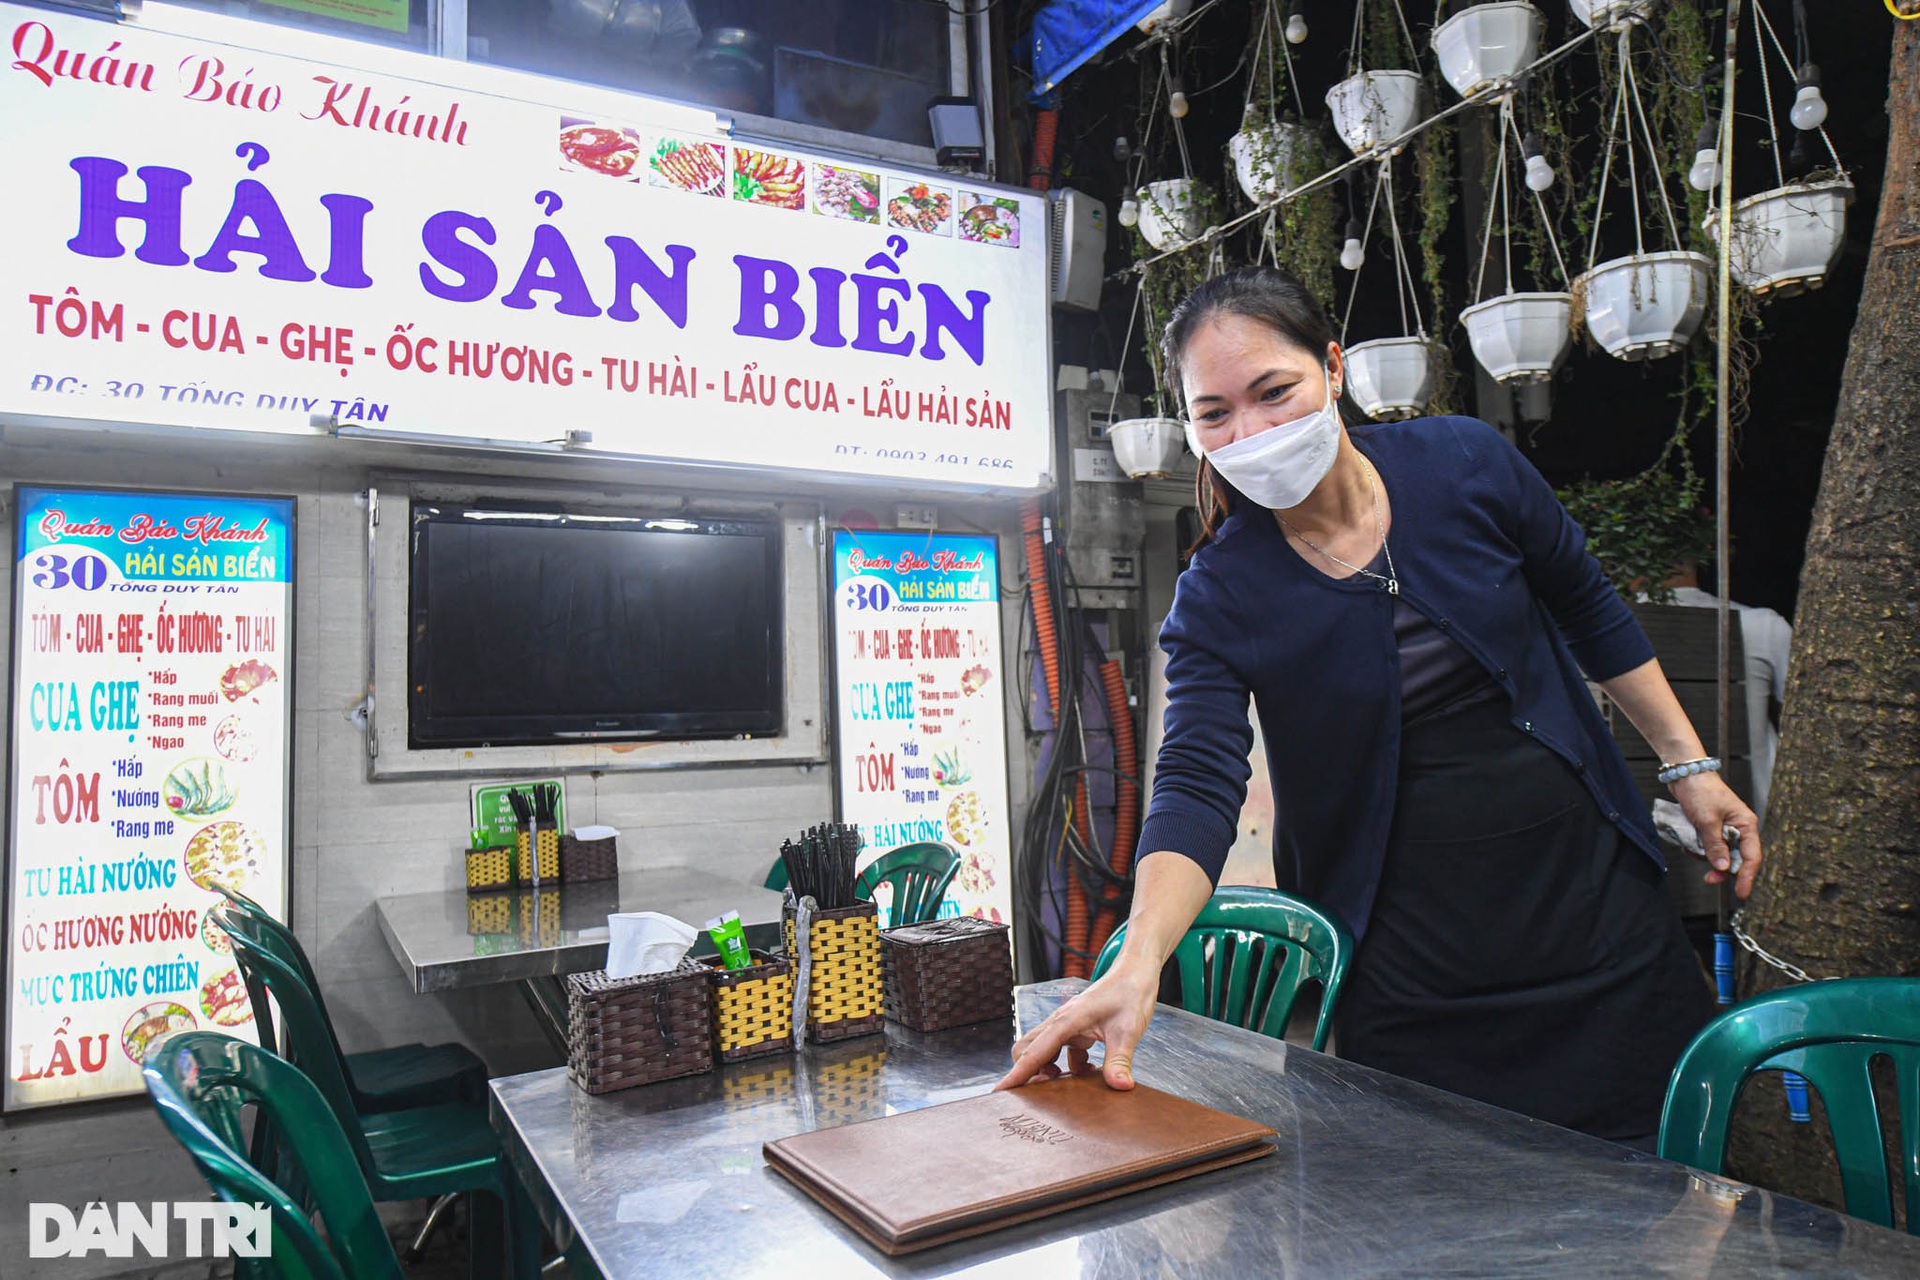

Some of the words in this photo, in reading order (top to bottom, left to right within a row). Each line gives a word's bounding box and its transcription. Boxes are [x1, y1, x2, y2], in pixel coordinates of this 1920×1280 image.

[11, 21, 156, 91] Quán
[299, 75, 471, 146] Khánh
[66, 141, 374, 289] HẢI
[419, 190, 696, 329] SẢN
[733, 234, 991, 366] BIỂN
[28, 286, 124, 342] TÔM
[162, 309, 245, 355] CUA
[280, 322, 354, 377] GHẸ
[386, 323, 438, 373] ỐC
[448, 340, 573, 386] HƯƠNG
[601, 356, 639, 393] TU
[649, 355, 697, 399] HÀI
[724, 362, 776, 406] LẨU
[784, 377, 839, 413] CUA
[863, 378, 910, 420] LẨU
[919, 385, 957, 425] HẢI
[965, 390, 1011, 430] SẢN
[331, 397, 389, 422] TÂN
[39, 508, 113, 541] Quán
[182, 513, 269, 545] Khánh
[33, 554, 107, 591] 30
[125, 546, 165, 576] HẢI
[171, 547, 217, 577] SẢN
[224, 546, 275, 578] BIỂN
[848, 547, 892, 574] Quán
[110, 580, 157, 593] TỐNG
[162, 584, 201, 593] DUY
[847, 584, 890, 611] 30
[76, 614, 103, 653] CUA
[117, 614, 144, 662] GHẸ
[157, 600, 174, 653] ỐC
[179, 611, 223, 653] HƯƠNG
[235, 615, 250, 652] TU
[873, 629, 890, 659] CUA
[30, 682, 82, 731] CUA
[90, 680, 140, 743] GHẸ
[153, 693, 184, 707] Rang
[885, 681, 914, 730] GHẸ
[153, 714, 184, 728] Rang
[188, 715, 207, 726] me
[152, 735, 184, 750] Ngao
[118, 754, 142, 779] Hấp
[855, 741, 895, 793] TÔM
[32, 757, 101, 824] TÔM
[117, 788, 159, 808] Nướng
[905, 789, 925, 804] Rang
[116, 820, 149, 839] Rang
[154, 820, 174, 836] me
[24, 867, 51, 897] TU
[58, 856, 95, 895] HÀI
[102, 852, 176, 892] NƯỚNG
[54, 915, 124, 950] HƯƠNG
[130, 902, 197, 944] NƯỚNG
[70, 961, 137, 1002] TRỨNG
[142, 952, 199, 995] CHIÊN
[18, 1016, 110, 1081] LẨU
